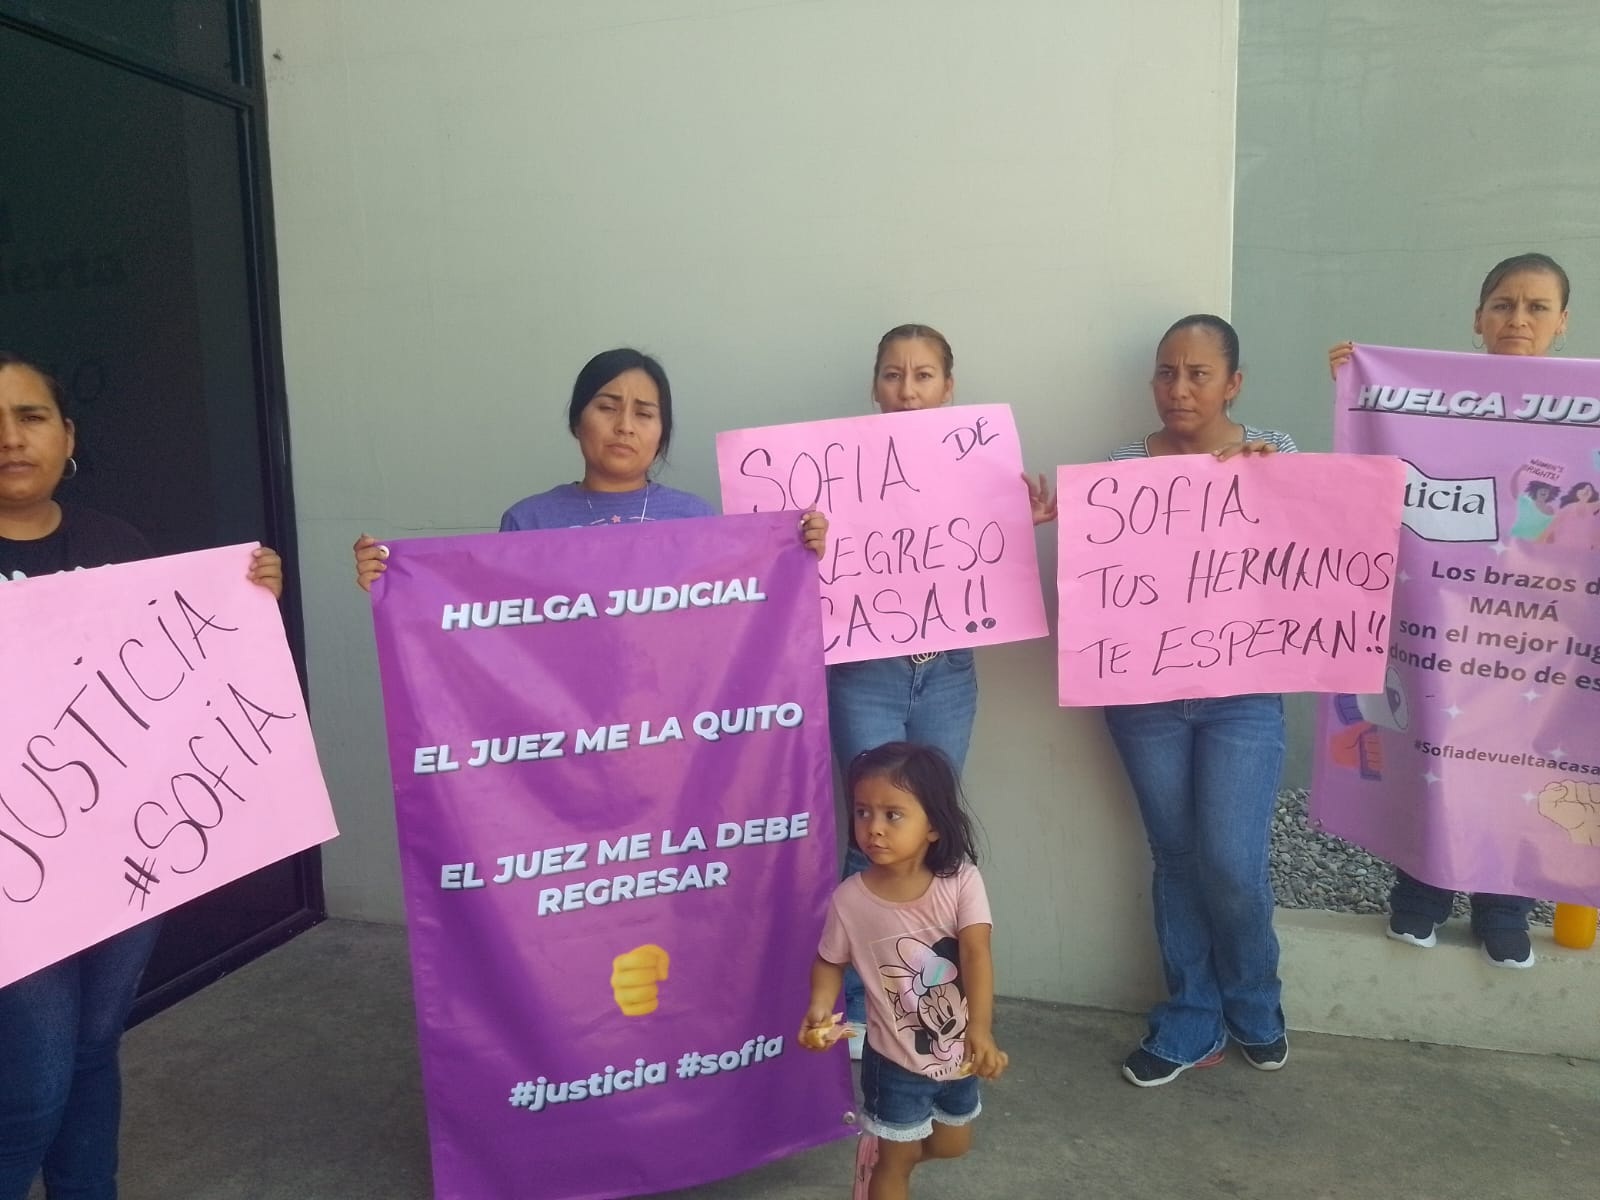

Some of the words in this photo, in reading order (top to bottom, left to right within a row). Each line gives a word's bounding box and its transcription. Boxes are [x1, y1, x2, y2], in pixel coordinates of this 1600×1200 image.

[1358, 384, 1505, 418] HUELGA
[1513, 393, 1600, 424] JUD
[740, 436, 920, 513] SOFIA
[942, 416, 999, 461] DE
[1086, 474, 1260, 544] SOFIA
[819, 518, 1004, 586] EGRESO
[1078, 564, 1159, 608] TUS
[1187, 541, 1394, 603] HERMANOS
[1432, 561, 1476, 581] Los
[1484, 566, 1576, 593] brazos
[441, 591, 598, 631] HUELGA
[605, 576, 768, 617] JUDICIAL
[1400, 619, 1437, 639] son
[1446, 625, 1469, 643] el
[1477, 631, 1559, 656] mejor
[1469, 596, 1559, 623] MAMÁ
[1078, 638, 1131, 678] TE
[1152, 610, 1387, 676] ESPERAN!!
[1390, 642, 1452, 672] donde
[1460, 657, 1526, 681] debo
[1534, 666, 1566, 685] de
[0, 590, 239, 903] JUSTICIA
[414, 745, 459, 774] EL
[468, 731, 565, 768] JUEZ
[575, 724, 631, 755] ME
[639, 716, 683, 745] LA
[692, 701, 804, 741] QUITO
[124, 683, 296, 912] #SOFIA
[440, 862, 484, 890] EL
[493, 842, 588, 885] JUEZ
[597, 832, 652, 865] ME
[661, 827, 707, 855] LA
[716, 812, 811, 848] DEBE
[538, 861, 730, 916] REGRESAR
[509, 1058, 668, 1112] #justicia
[676, 1034, 784, 1078] #sofia
